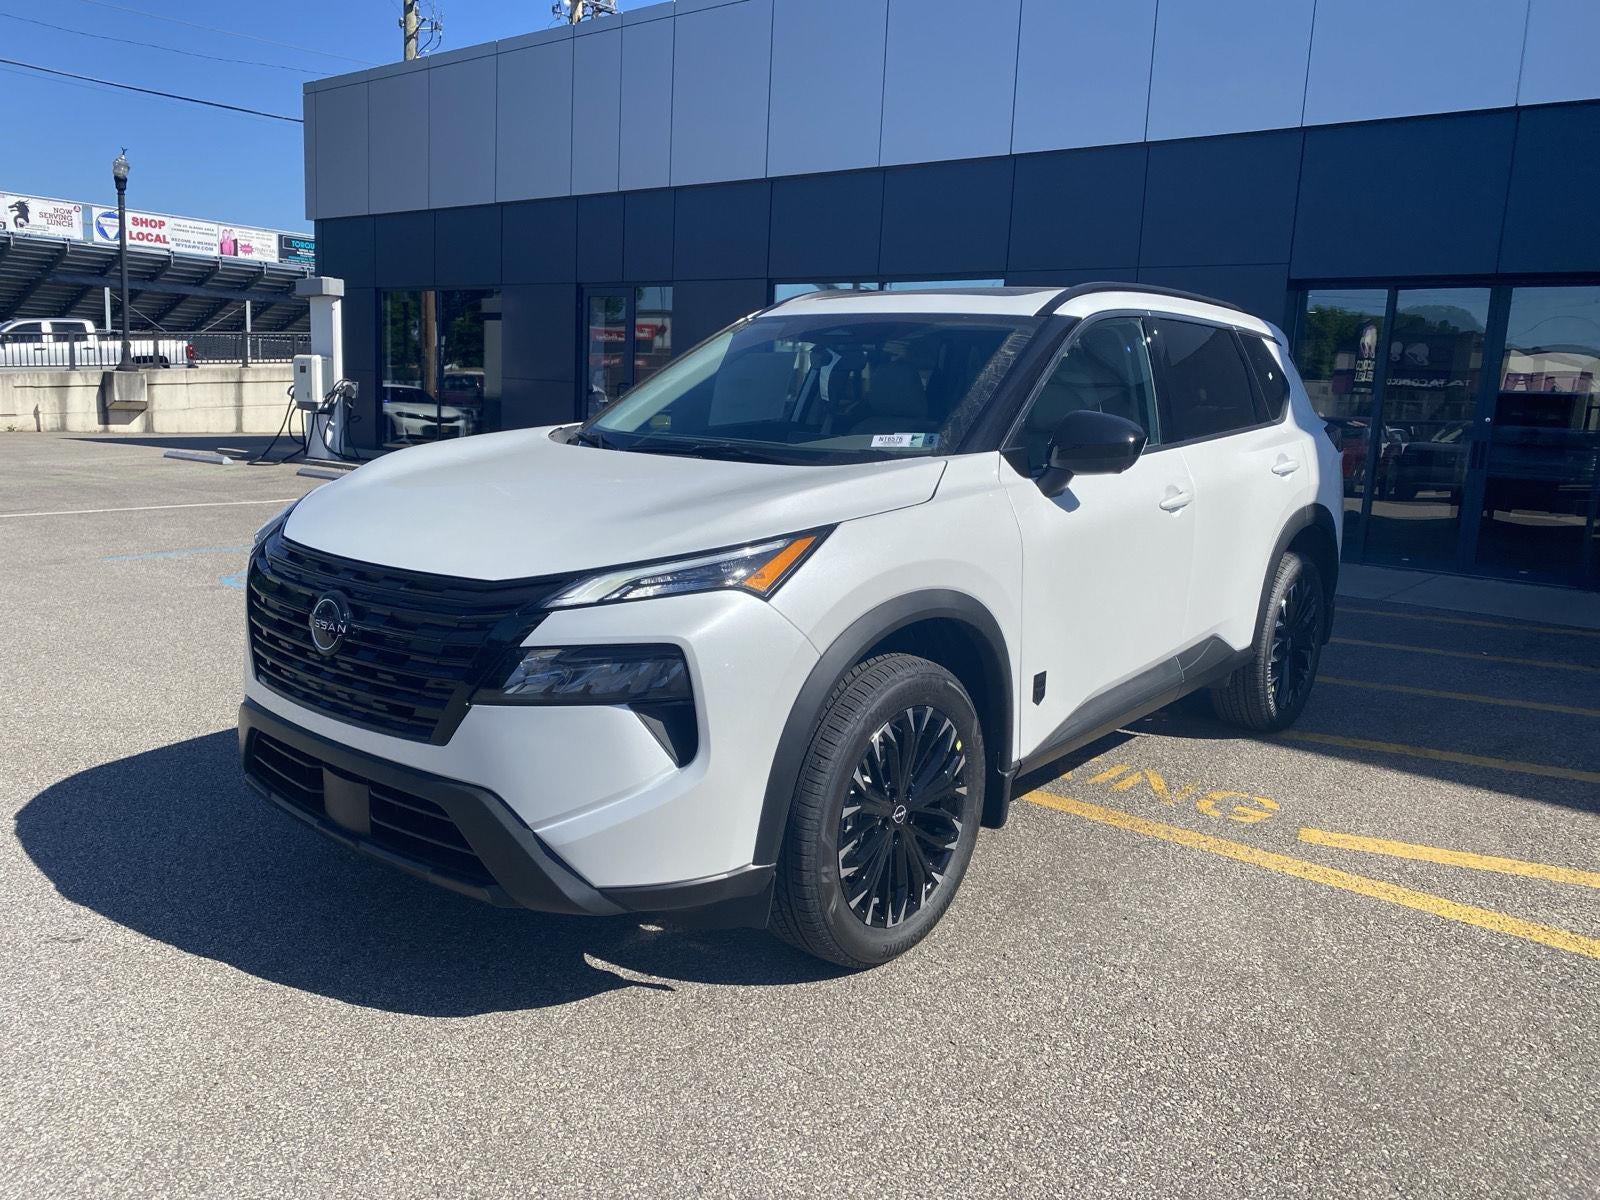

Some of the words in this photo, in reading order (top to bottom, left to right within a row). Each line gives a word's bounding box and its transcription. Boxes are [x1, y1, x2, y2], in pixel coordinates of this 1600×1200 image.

[39, 211, 73, 221] SERVING
[53, 207, 73, 215] NOW
[46, 219, 73, 228] LUNCH
[131, 216, 166, 229] SHOP
[129, 231, 170, 244] LOCAL
[291, 240, 315, 249] TORQU
[314, 618, 347, 634] SSAN
[1061, 758, 1281, 824] ING
